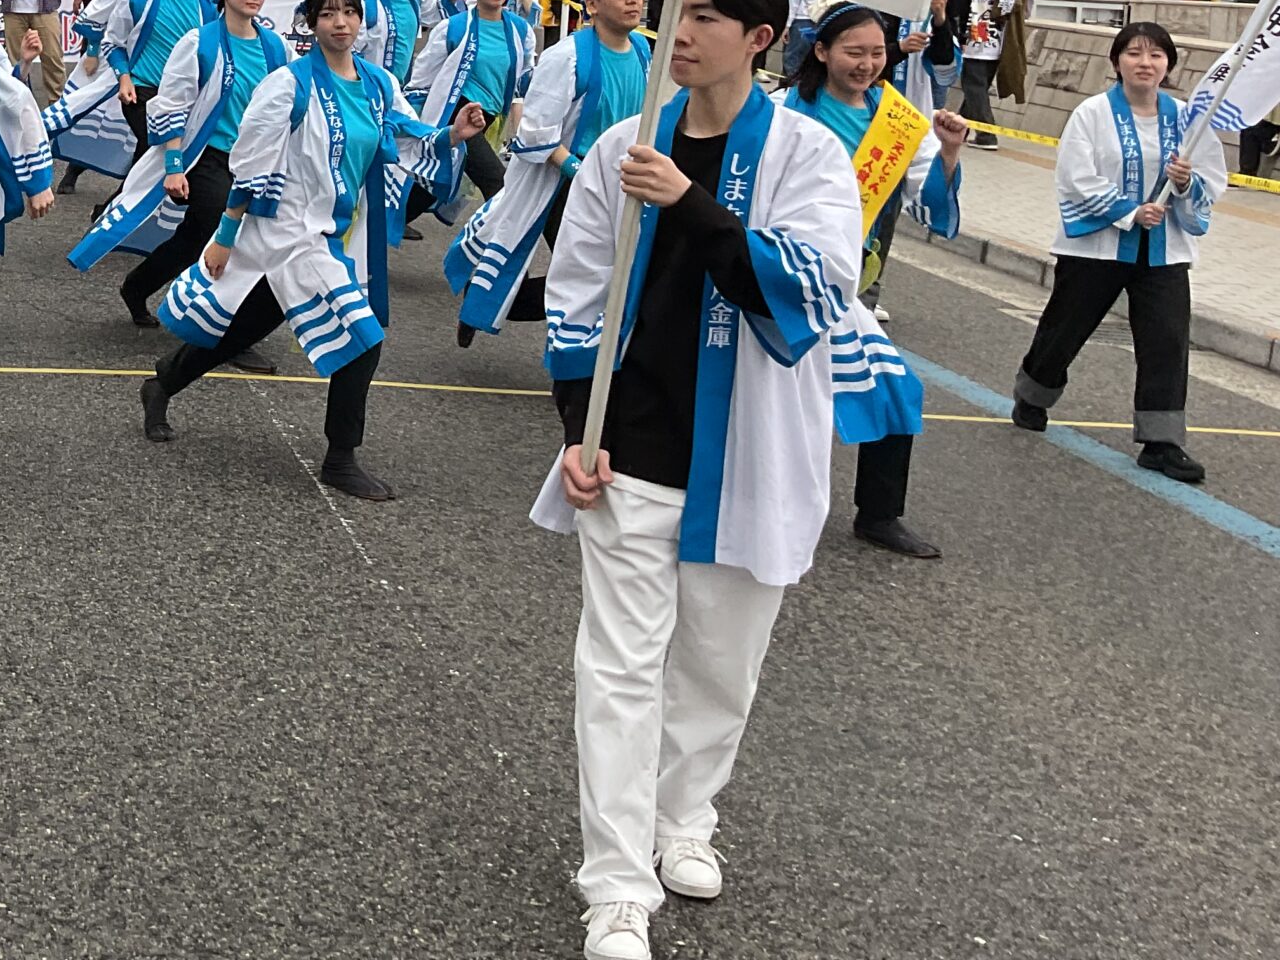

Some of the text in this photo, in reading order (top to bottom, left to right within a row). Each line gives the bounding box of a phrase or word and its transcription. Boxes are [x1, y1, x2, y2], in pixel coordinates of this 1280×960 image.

[448, 33, 477, 105] しまなみ信用金庫
[320, 87, 348, 195] しまなみ信用金庫
